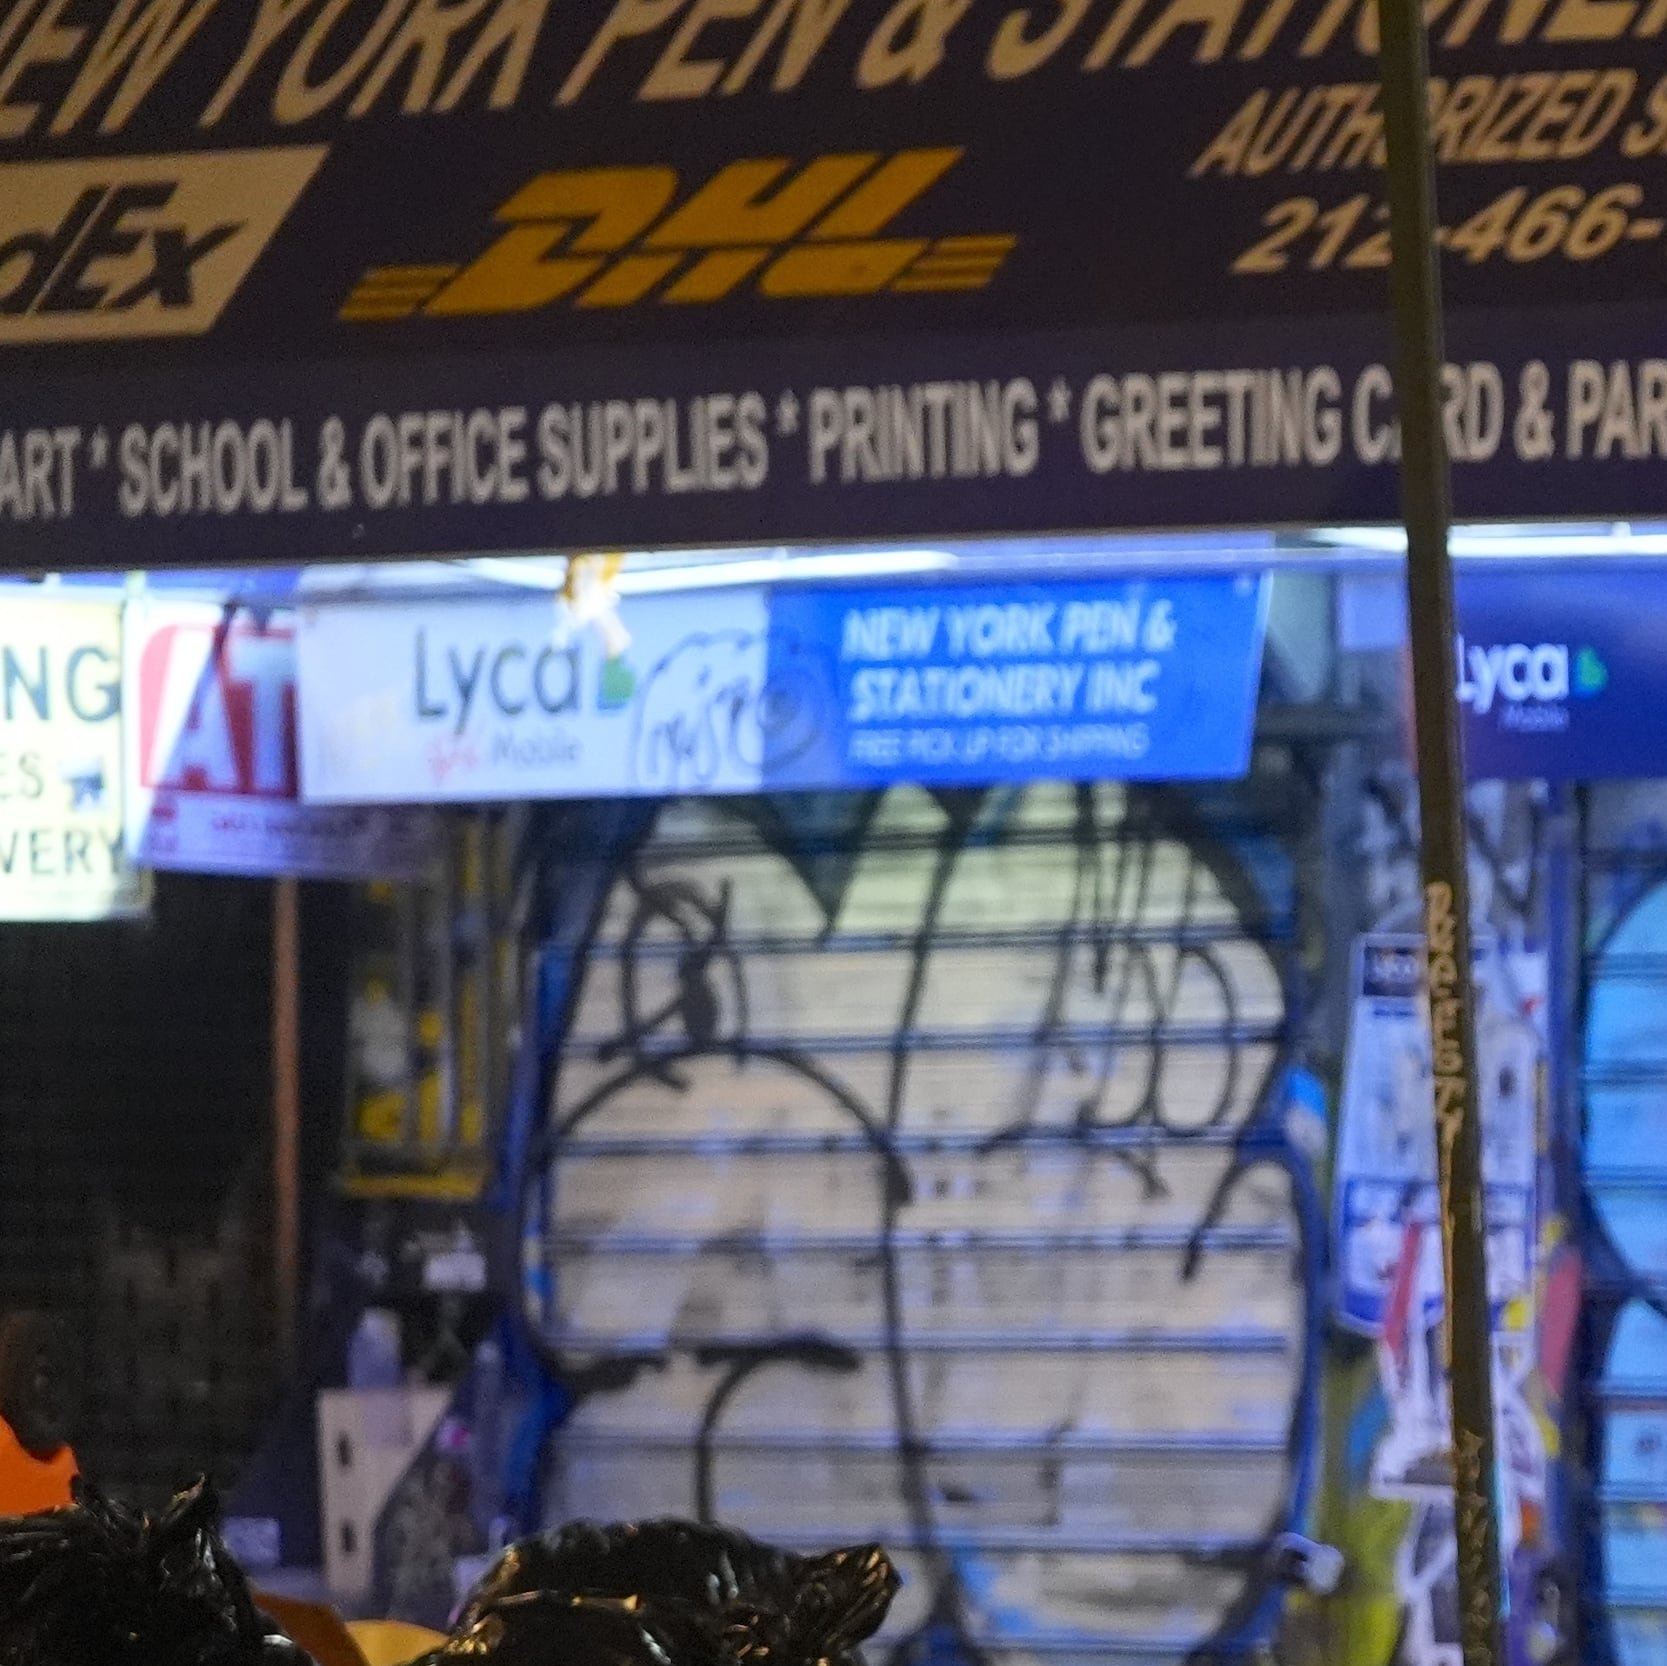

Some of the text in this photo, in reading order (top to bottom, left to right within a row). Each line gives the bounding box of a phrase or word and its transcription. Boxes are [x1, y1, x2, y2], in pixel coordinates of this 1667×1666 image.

[0, 0, 215, 137] EW
[1187, 68, 1638, 178] AUTHRIZED
[0, 180, 248, 316] dEx
[420, 147, 966, 317] DHL
[117, 414, 308, 517] SCHOOL
[317, 412, 351, 511] &
[359, 405, 529, 508] OFFICE
[537, 392, 769, 500] SUPPLIES
[809, 377, 1040, 486] PRINTING
[1080, 365, 1343, 474] GREETING
[1352, 362, 1503, 466] CRD
[1513, 359, 1555, 461] &
[414, 626, 582, 737] Lyca
[843, 605, 941, 662] NEW
[944, 603, 1058, 657] YORK
[1059, 600, 1141, 655] PEN
[847, 658, 1162, 724] STATIONERY INC
